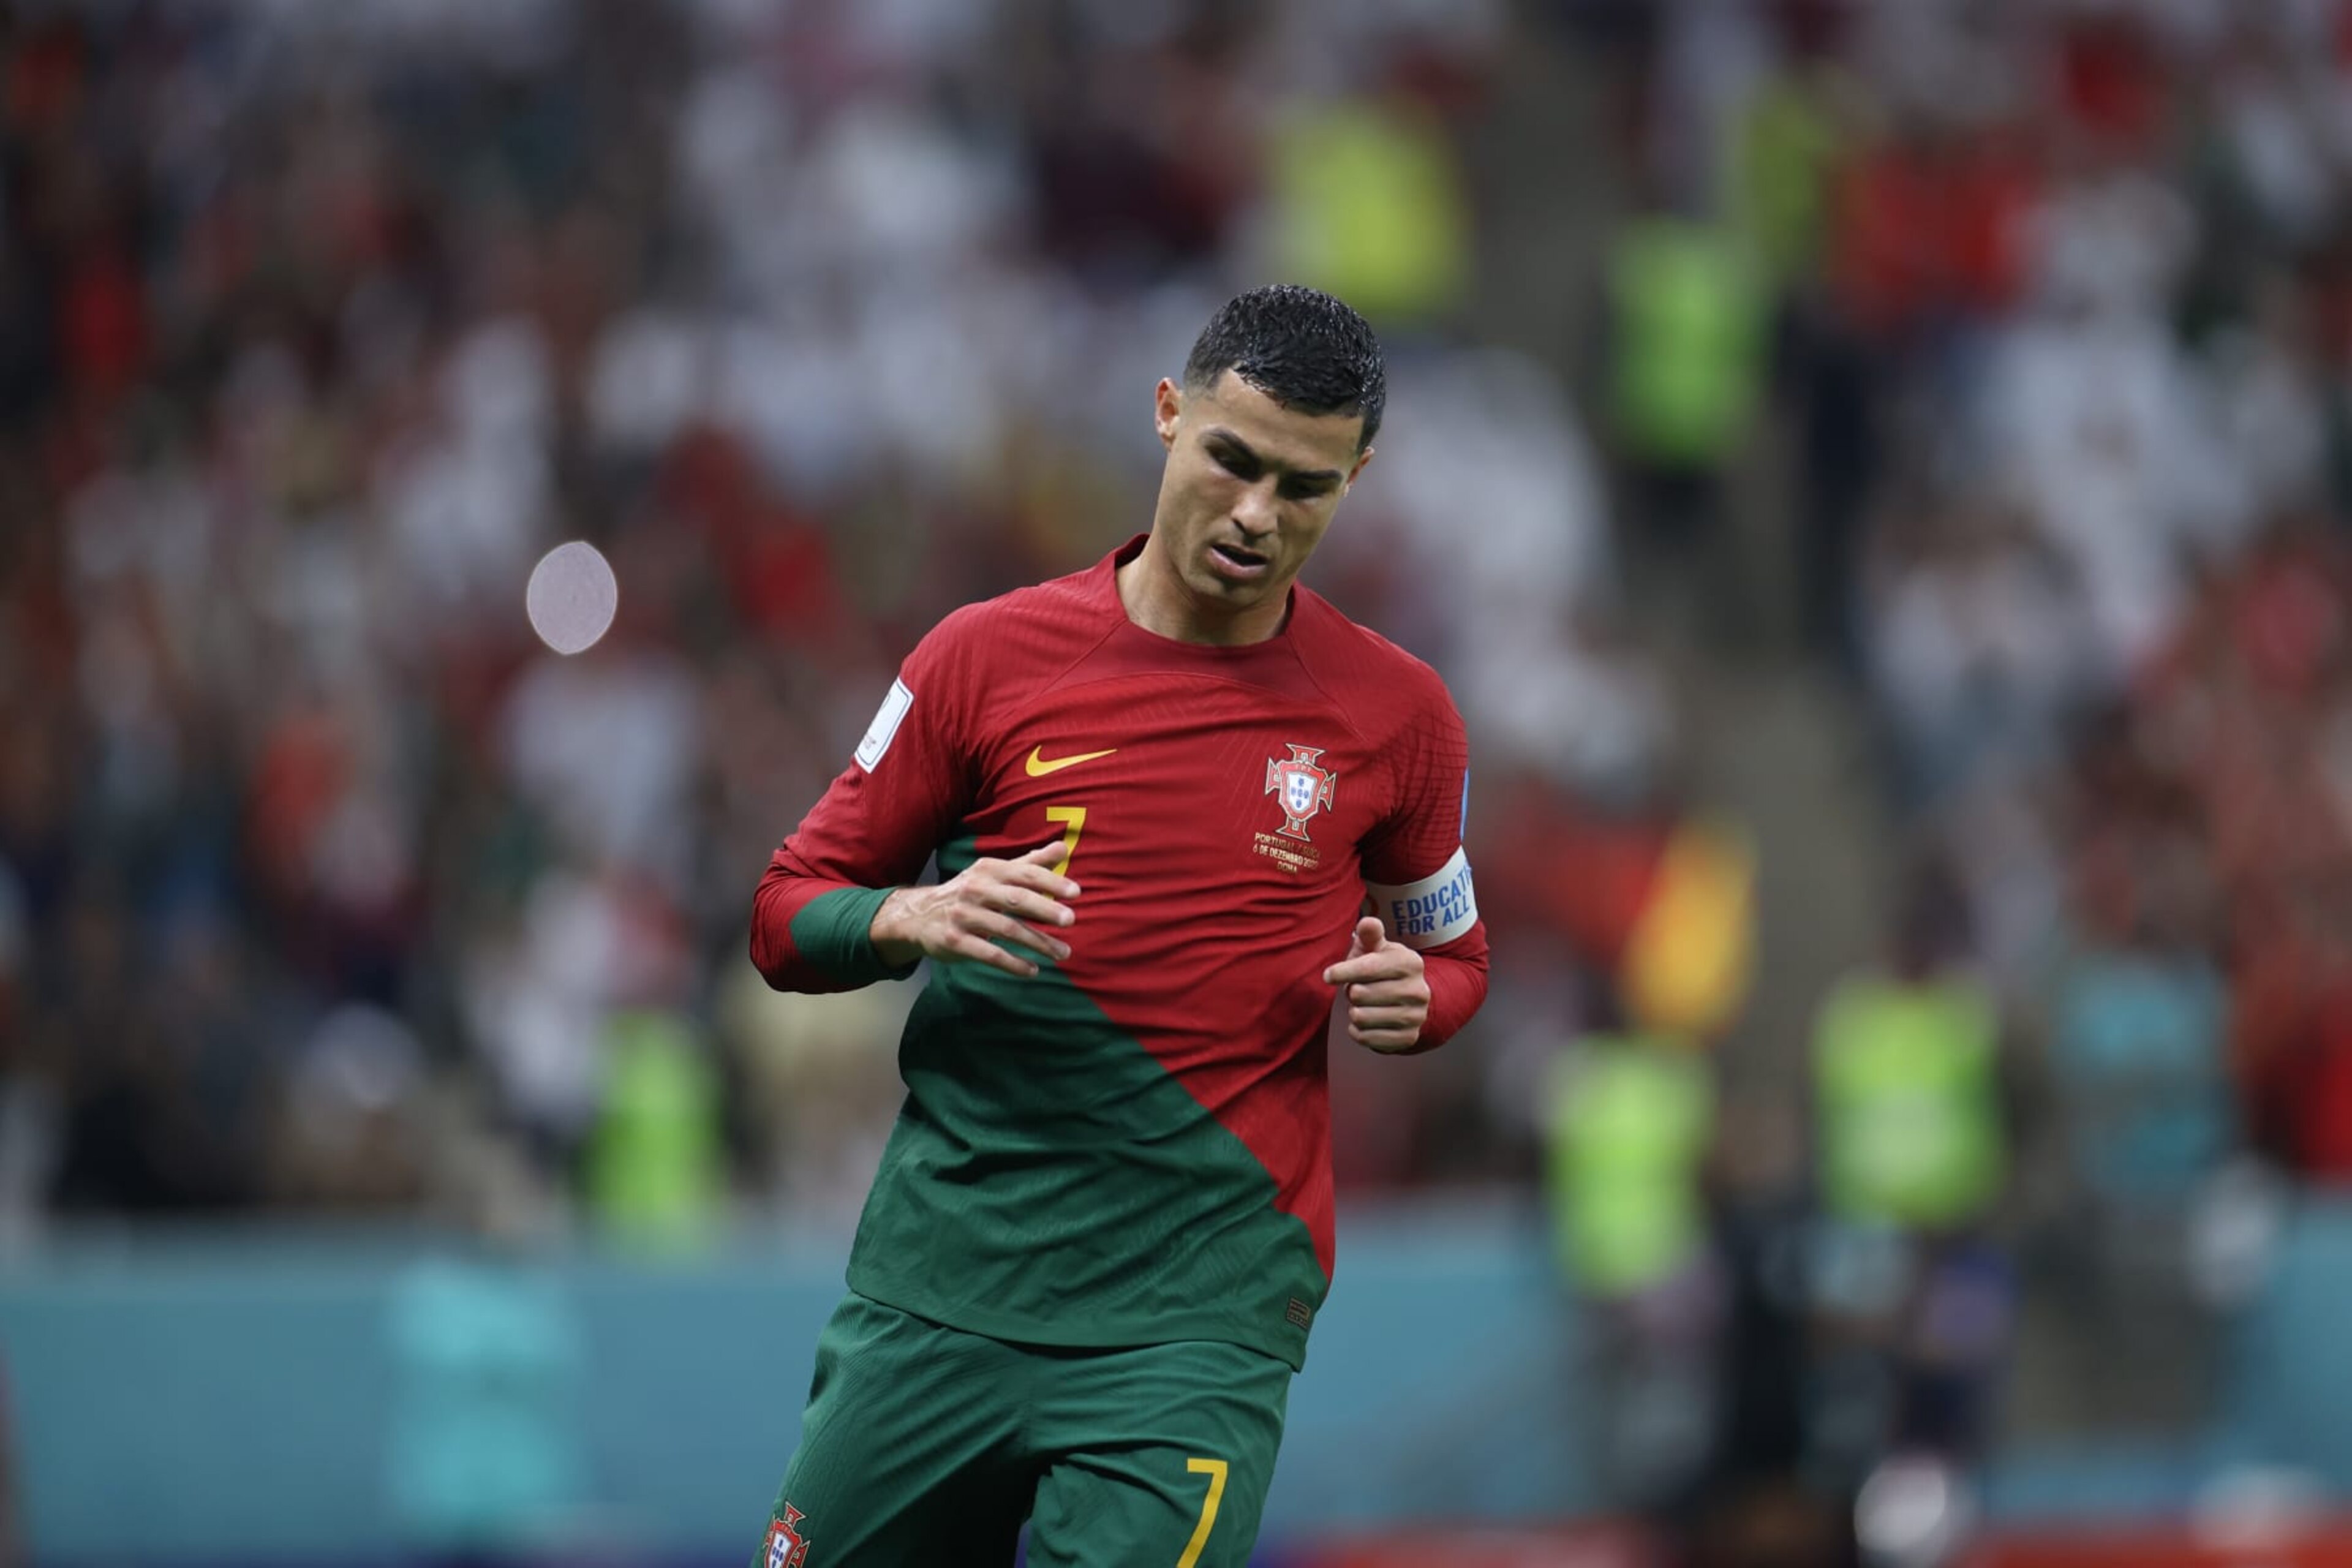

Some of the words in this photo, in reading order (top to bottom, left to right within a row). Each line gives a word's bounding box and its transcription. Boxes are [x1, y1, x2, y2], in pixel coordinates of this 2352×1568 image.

[1046, 806, 1087, 900] 7
[1253, 843, 1257, 853] 6
[1259, 845, 1268, 856] DE
[1270, 847, 1303, 865] DEZEMBRO
[1254, 832, 1294, 850] PORTUGAL
[1396, 916, 1434, 936] FOR
[1442, 895, 1469, 927] ALL
[1177, 1458, 1227, 1568] 7
